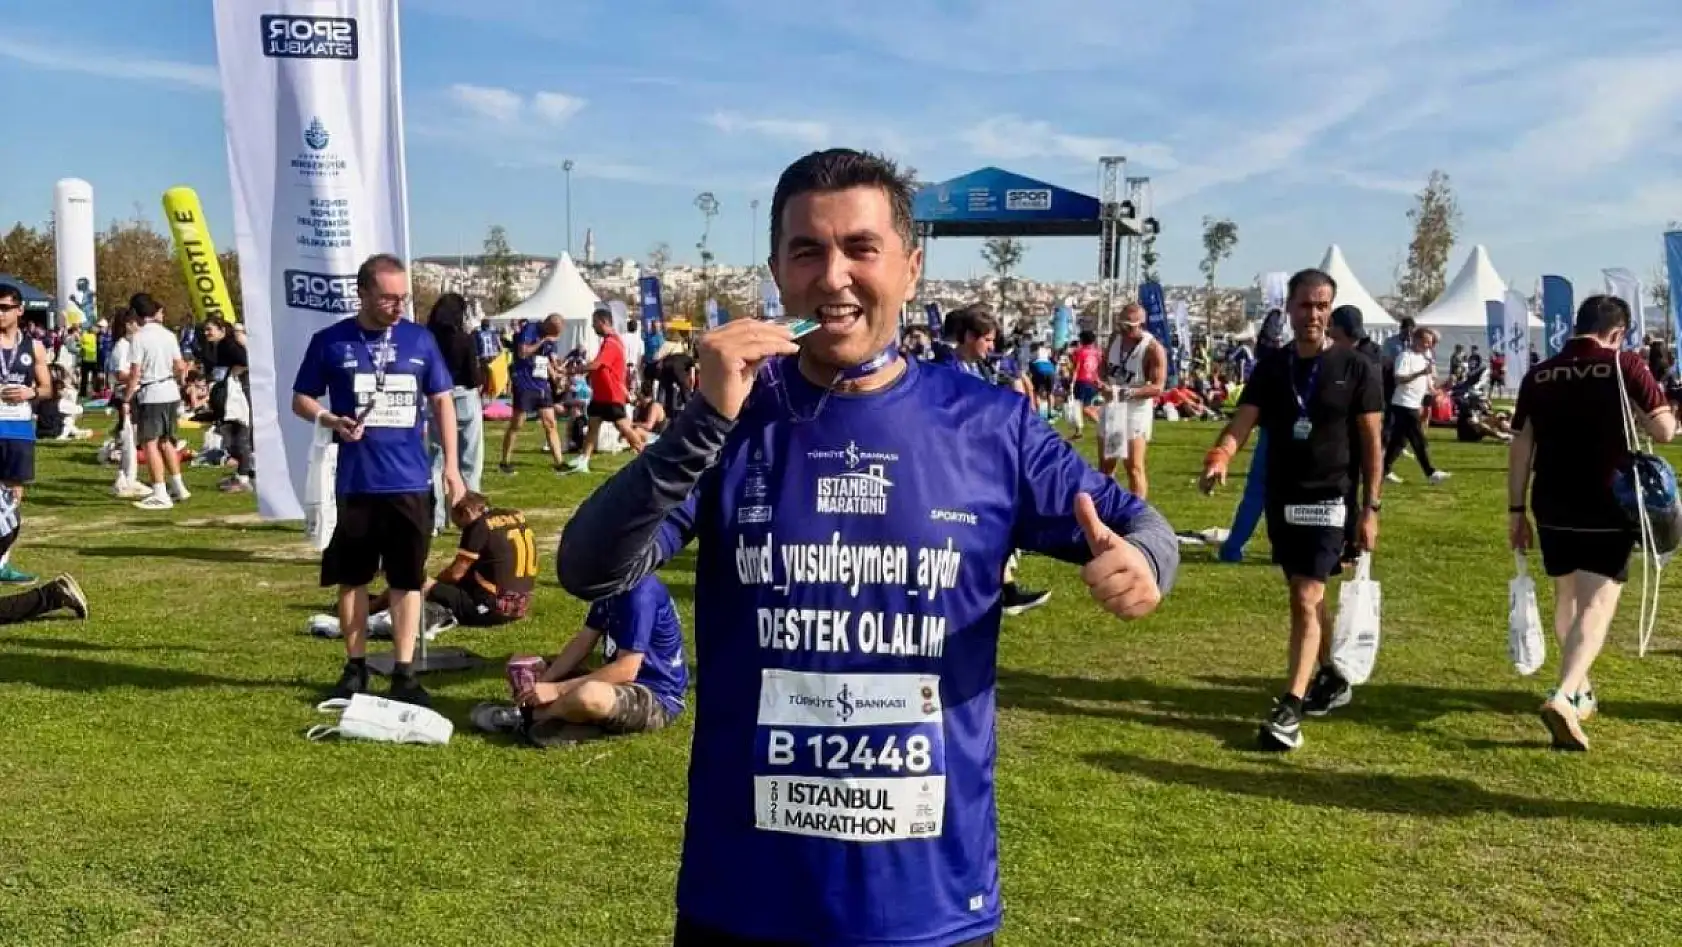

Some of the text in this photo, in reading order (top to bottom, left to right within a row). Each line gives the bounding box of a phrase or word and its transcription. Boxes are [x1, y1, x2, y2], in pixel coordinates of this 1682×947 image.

[1009, 191, 1049, 201] SPOR
[816, 497, 888, 516] MARATONU
[757, 608, 850, 653] DESTEK
[858, 611, 946, 658] OLALIM
[855, 699, 906, 709] BANKASI
[768, 729, 932, 773] B 12448
[788, 782, 895, 810] ISTANBUL
[784, 808, 896, 836] MARATHON
